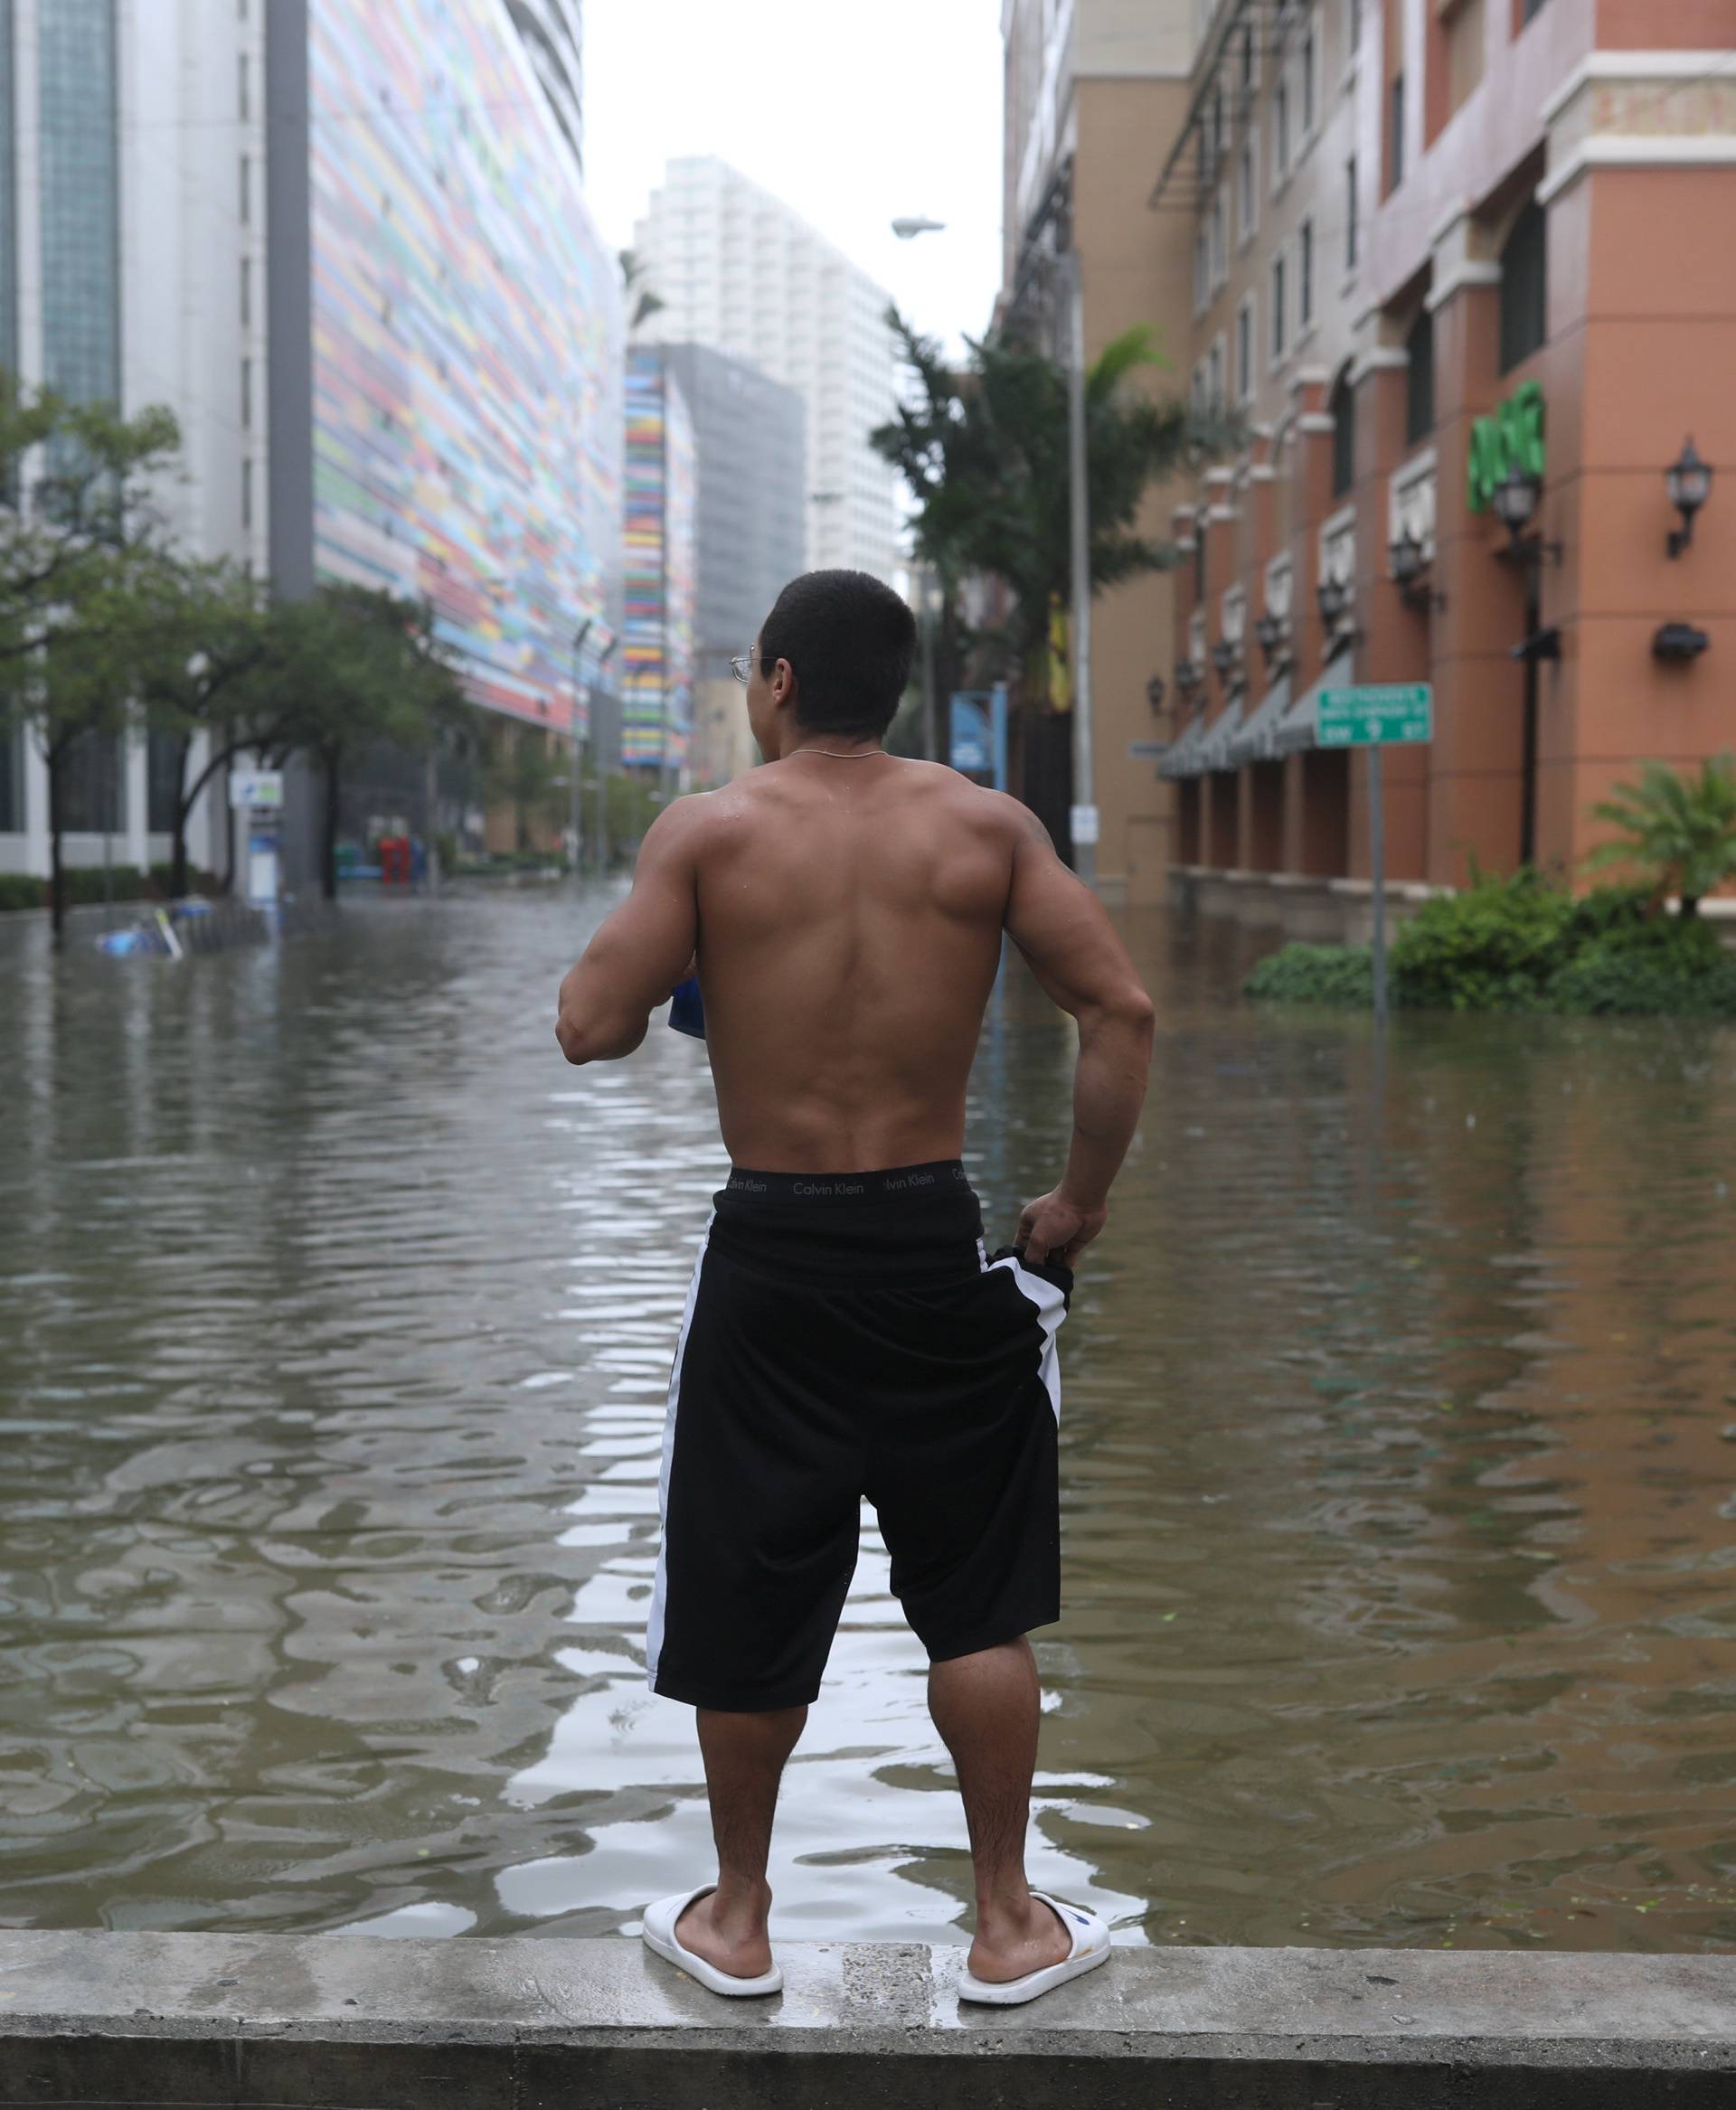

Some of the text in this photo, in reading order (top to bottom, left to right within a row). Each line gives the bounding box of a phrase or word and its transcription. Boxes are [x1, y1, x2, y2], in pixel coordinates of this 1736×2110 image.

[744, 1179, 767, 1192] Klein
[793, 1182, 833, 1195] Calvin
[835, 1182, 864, 1195] Klein
[884, 1177, 907, 1190] lvin
[907, 1172, 935, 1187] Klein
